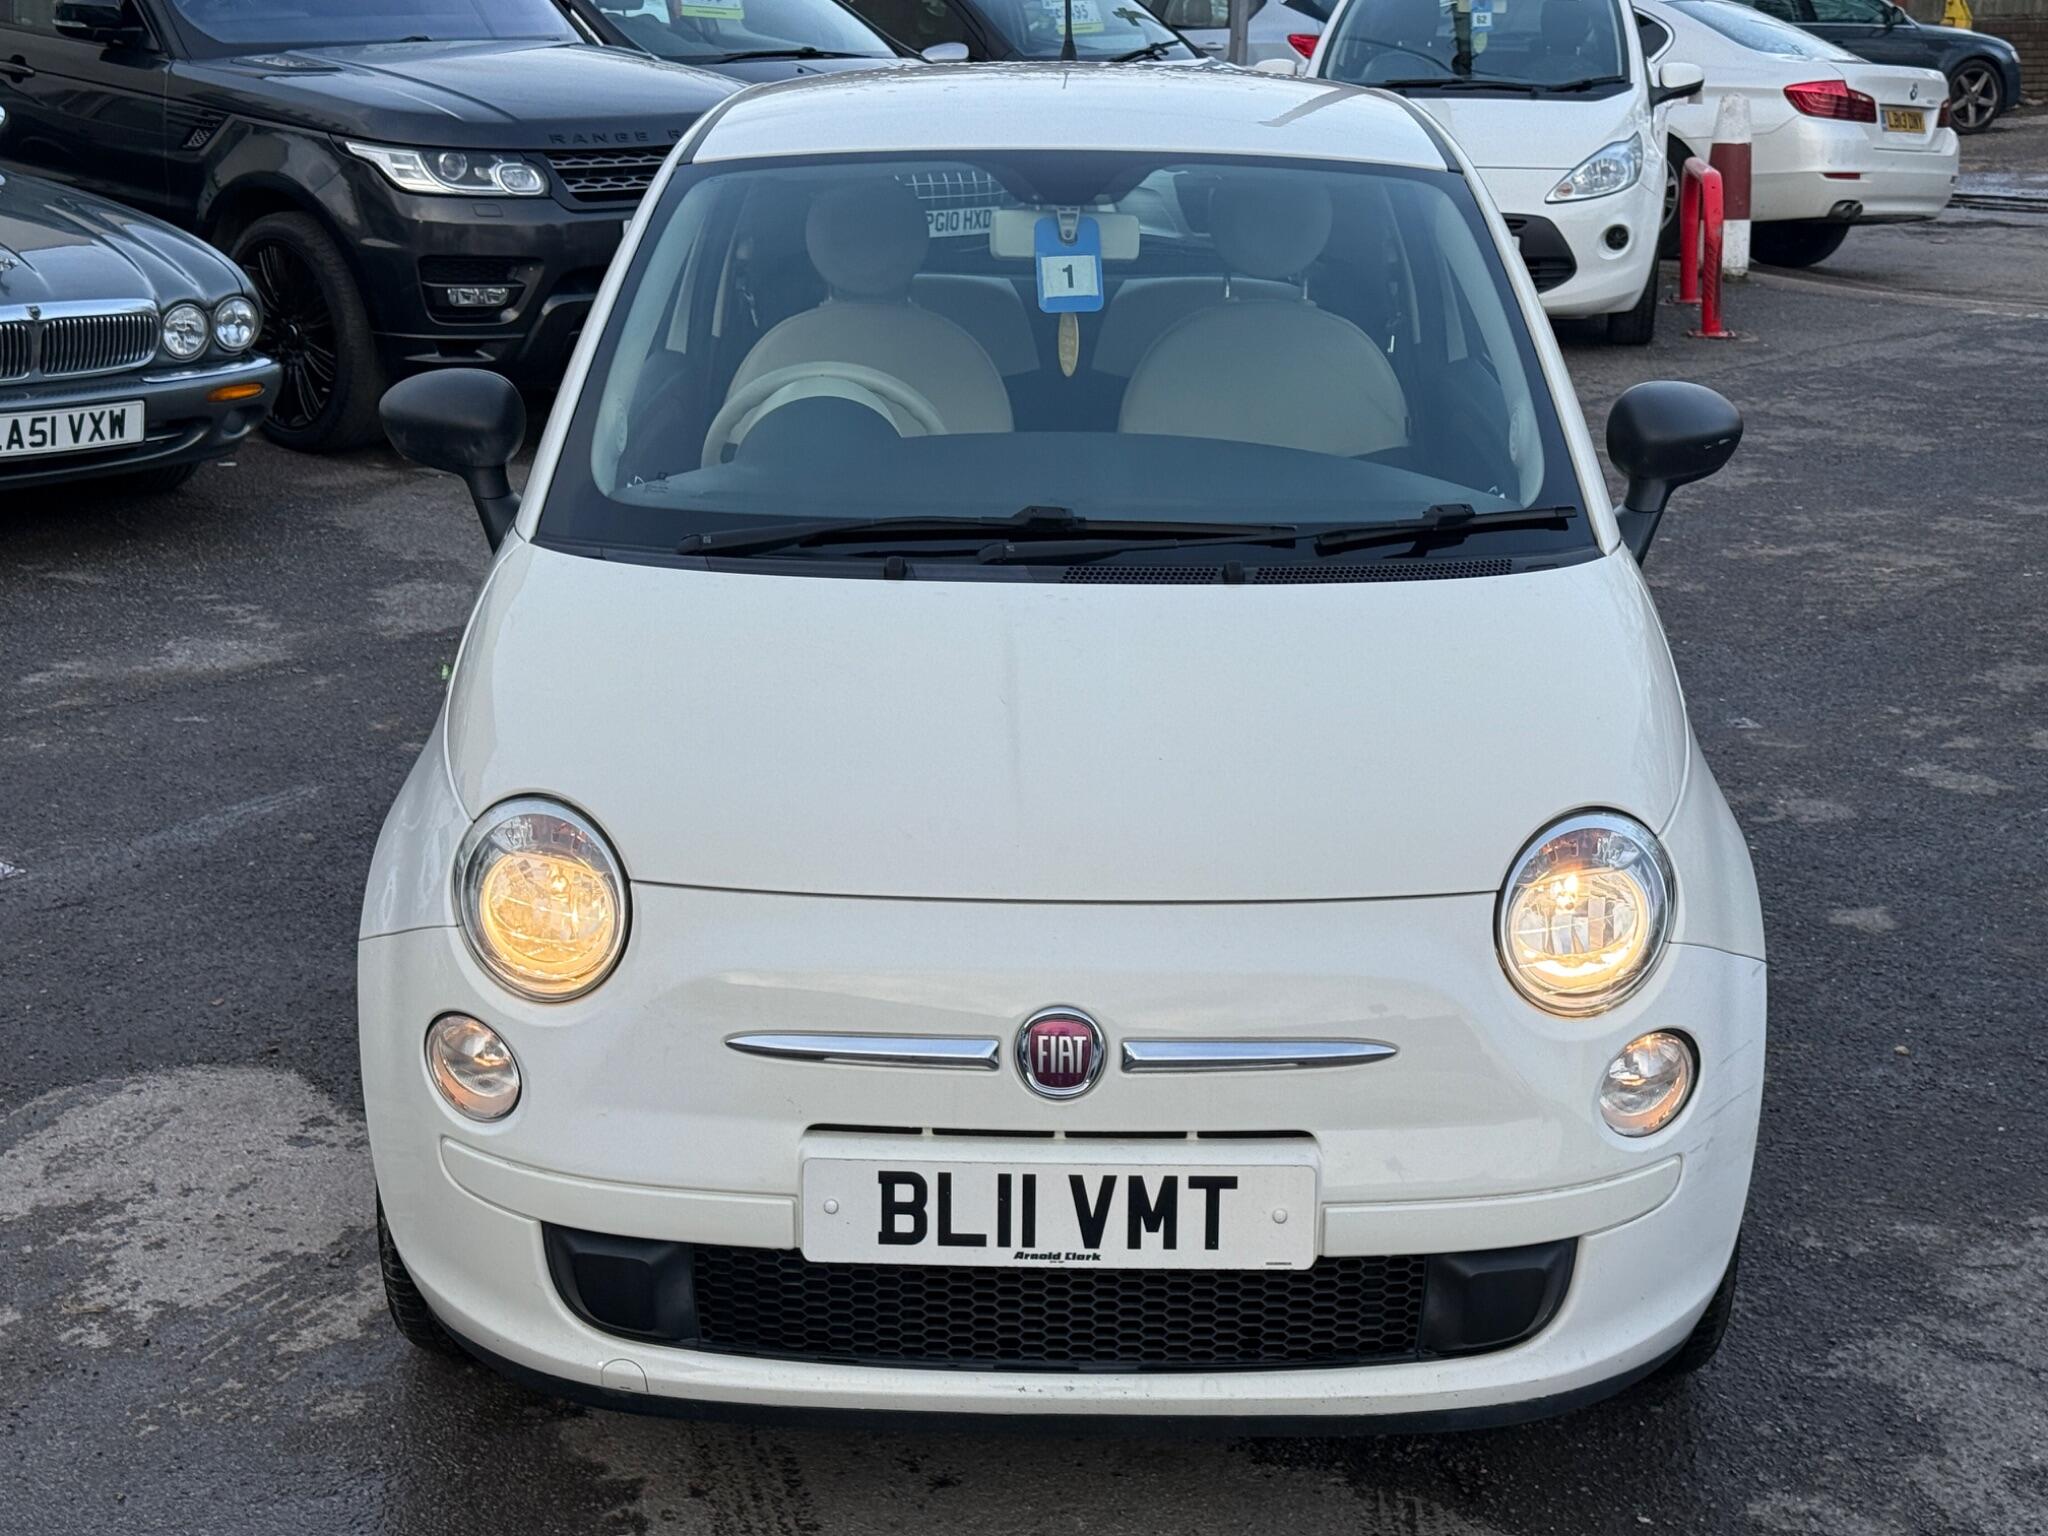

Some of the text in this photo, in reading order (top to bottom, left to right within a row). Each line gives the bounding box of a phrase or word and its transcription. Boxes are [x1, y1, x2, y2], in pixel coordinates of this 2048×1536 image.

[548, 131, 649, 144] RANGE
[1062, 264, 1074, 288] 1
[0, 408, 126, 451] A51 VXW
[1037, 1035, 1087, 1074] FIAT
[878, 1170, 1238, 1250] BL11 VMT
[1013, 1251, 1102, 1261] Arnold Clark
